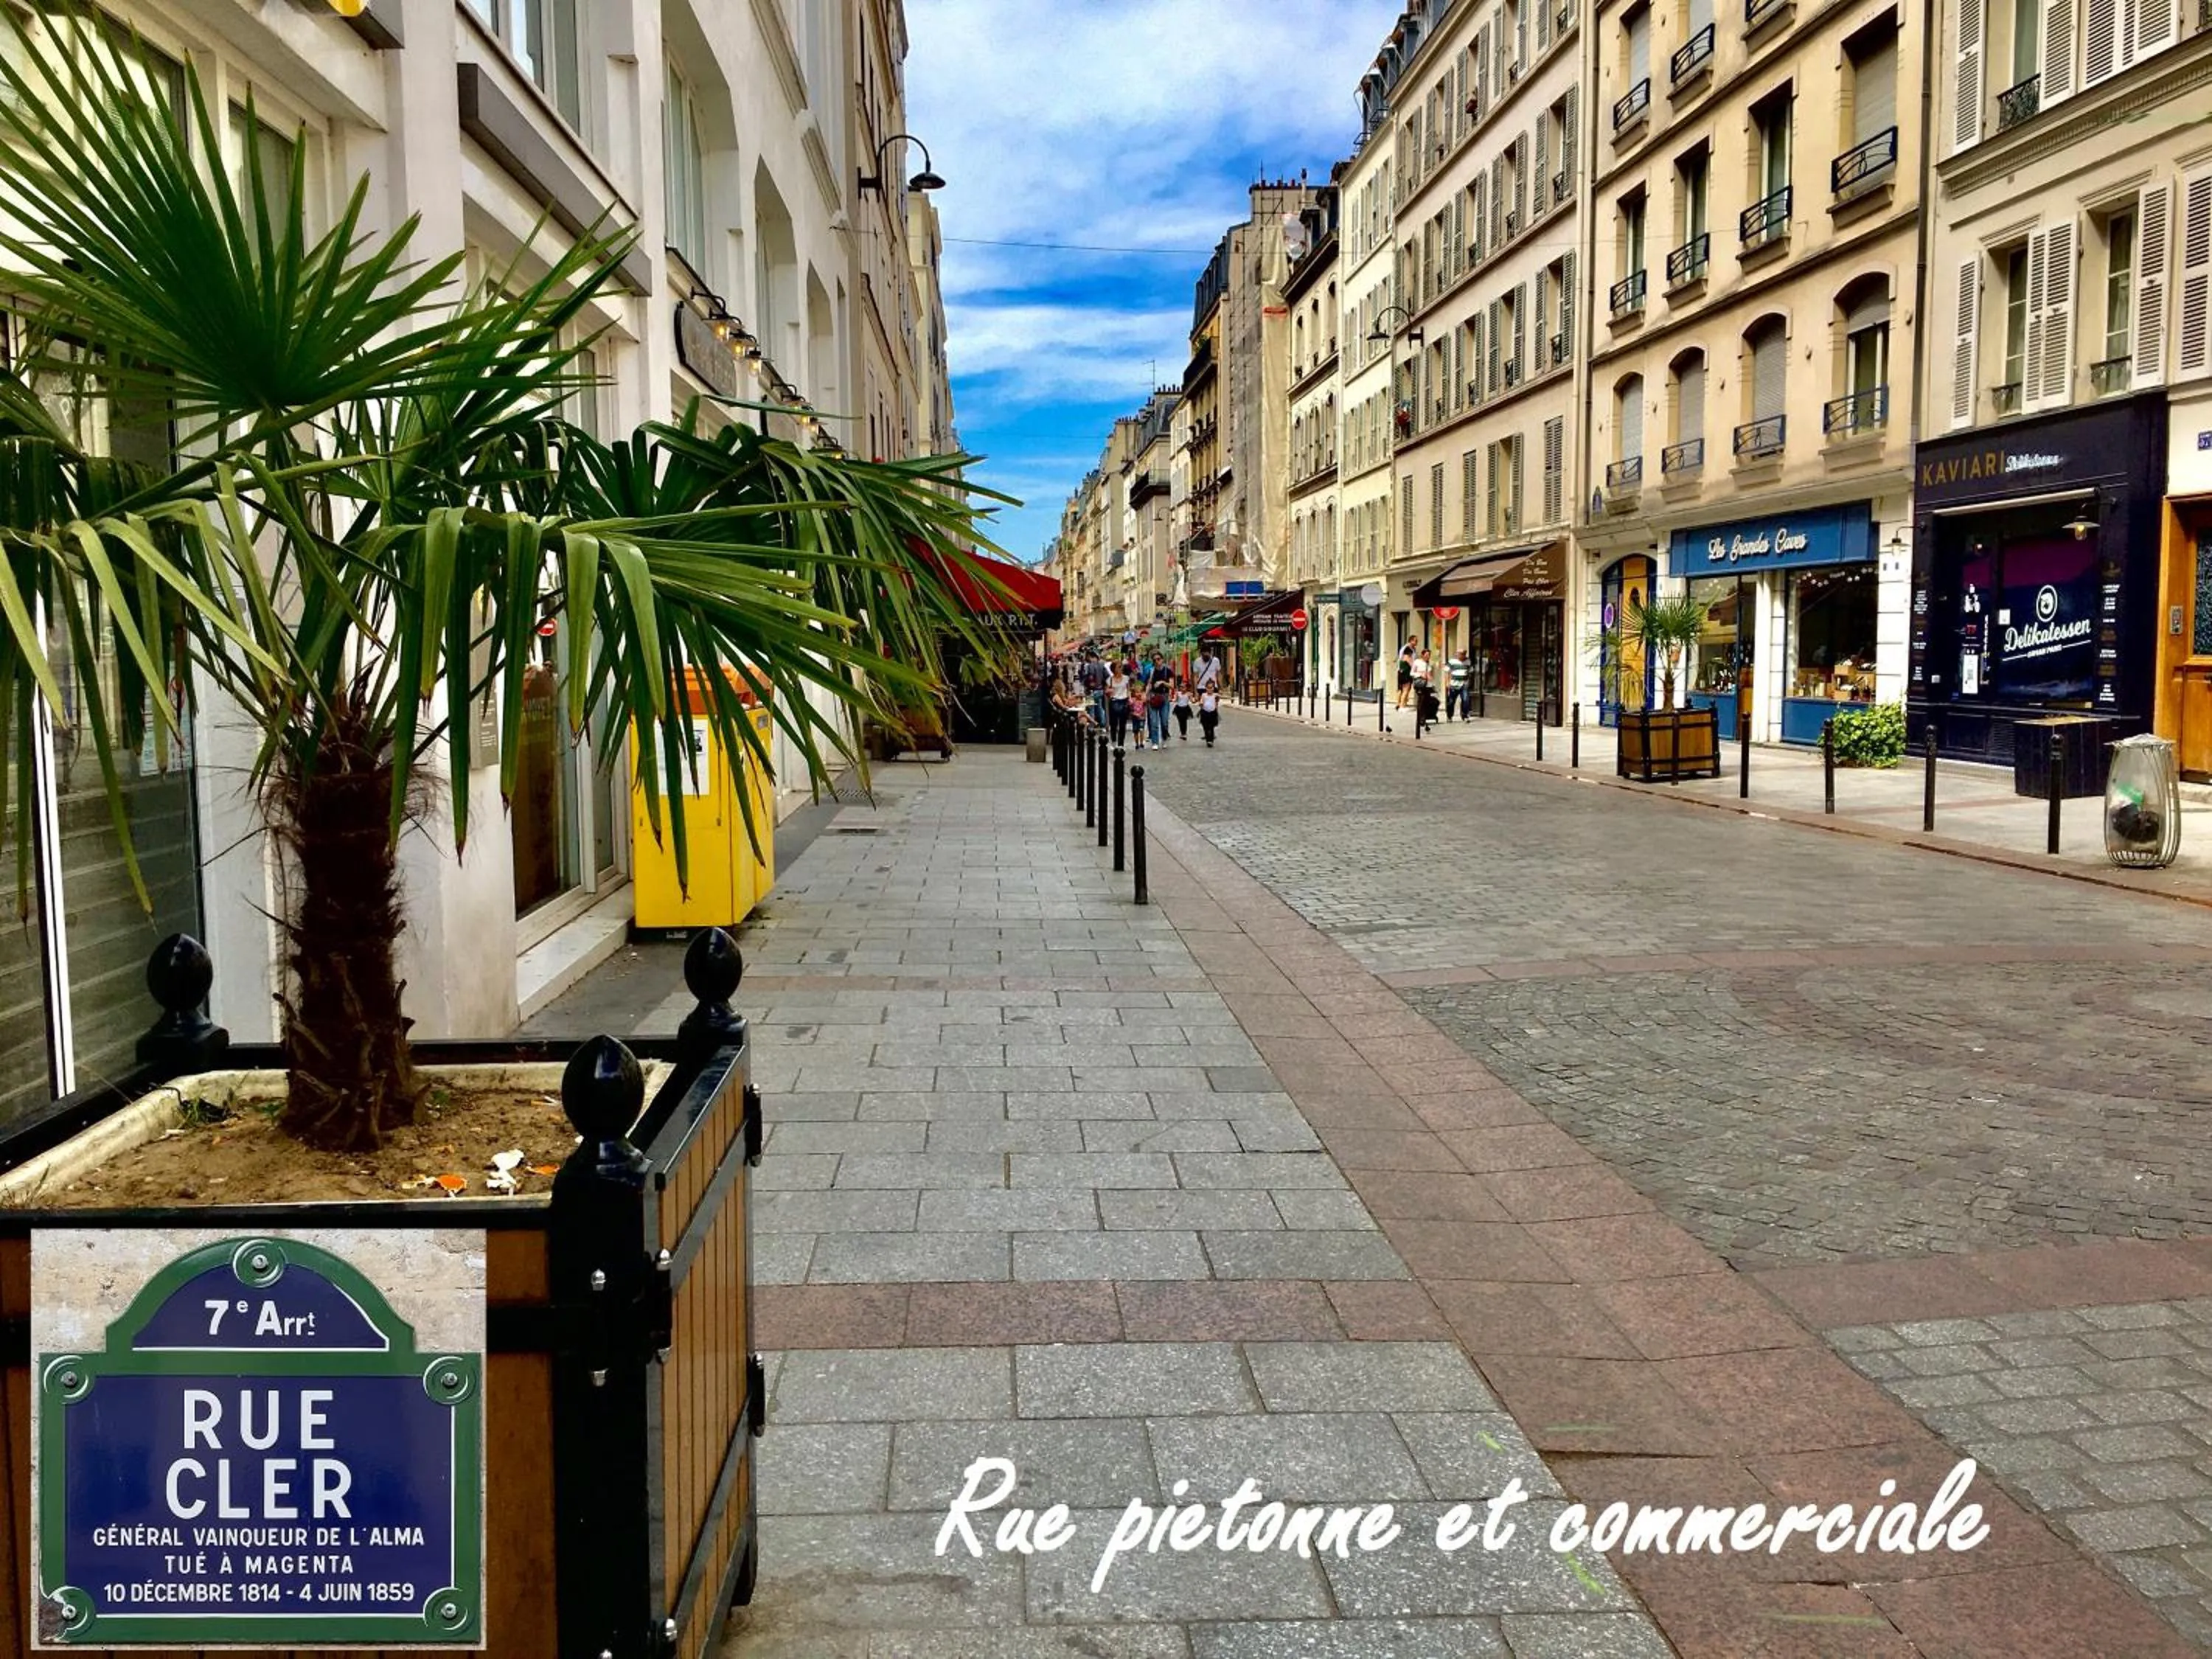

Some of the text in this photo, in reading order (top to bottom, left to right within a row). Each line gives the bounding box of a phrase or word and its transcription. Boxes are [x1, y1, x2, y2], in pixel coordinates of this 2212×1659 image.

[1922, 451, 2005, 487] KAVIARI
[1730, 532, 1770, 561] Grandes
[1775, 528, 1807, 553] Caves
[2004, 619, 2092, 652] Delikatessen
[255, 1300, 315, 1336] Arrt
[183, 1390, 335, 1450] RUE
[166, 1458, 352, 1520] CLER
[93, 1523, 184, 1546] GÉNÉRAL
[193, 1528, 307, 1548] VAINQUEUR
[316, 1527, 341, 1546] DE
[164, 1551, 354, 1574] TUÉ À MAGENTA
[104, 1583, 126, 1602] 10
[131, 1579, 233, 1602] DÉCEMBRE
[238, 1583, 281, 1602] 1814
[299, 1583, 313, 1601] 4
[318, 1583, 362, 1601] JUIN
[367, 1583, 414, 1601] 1859
